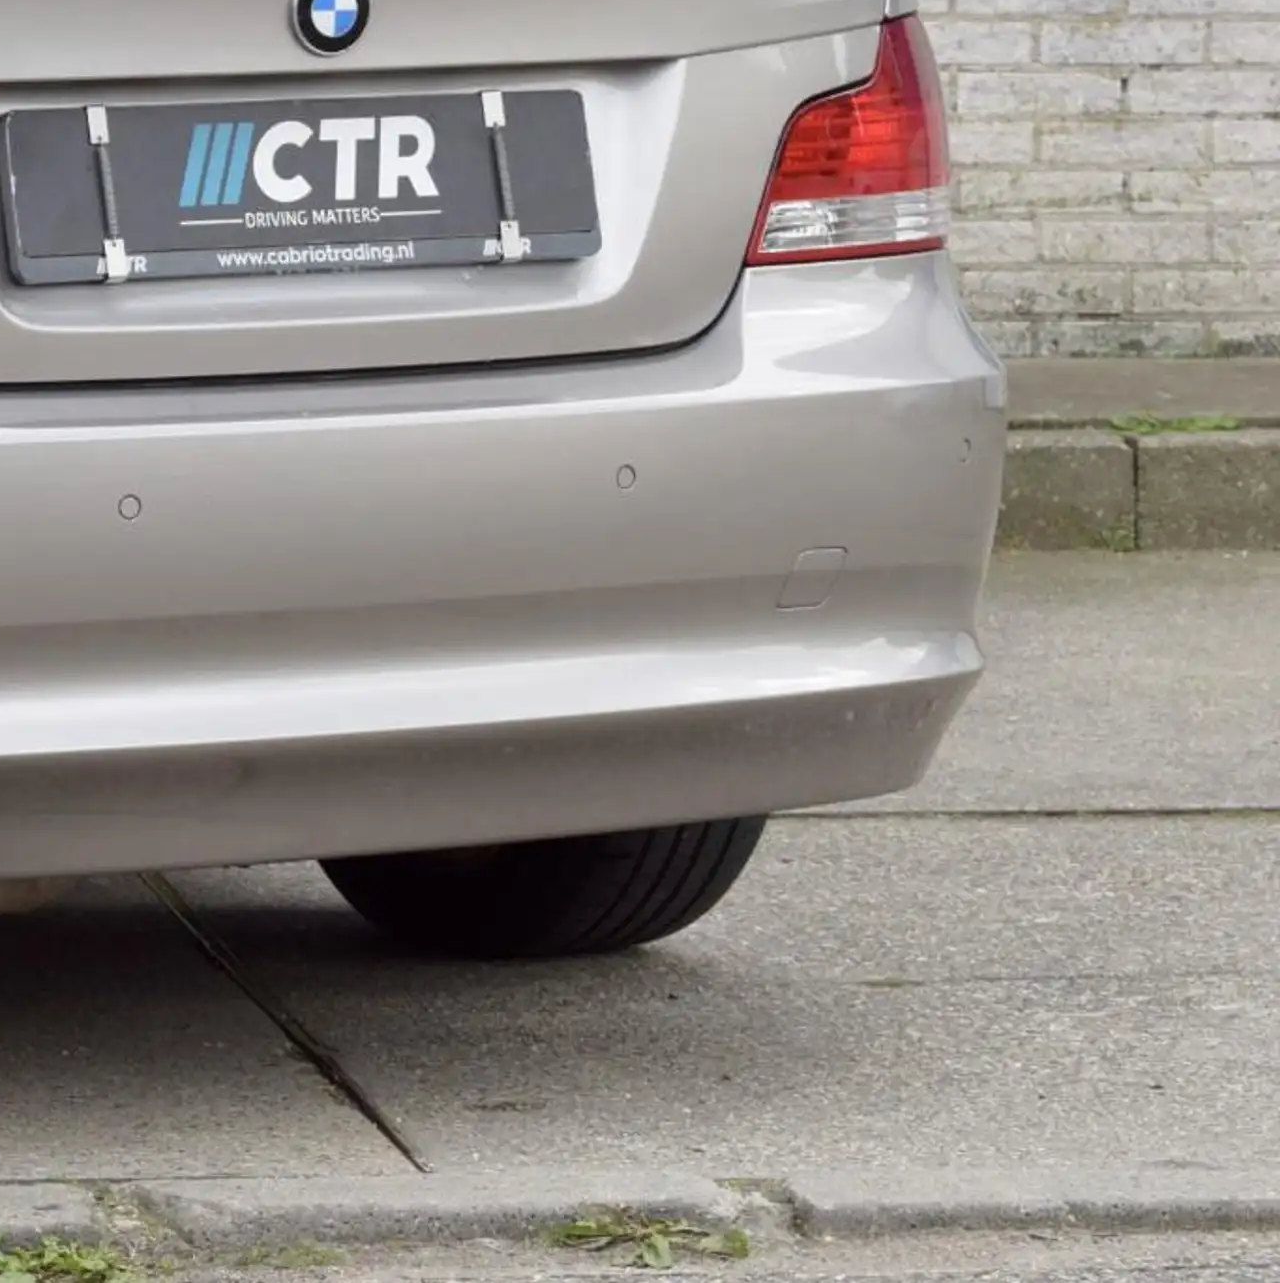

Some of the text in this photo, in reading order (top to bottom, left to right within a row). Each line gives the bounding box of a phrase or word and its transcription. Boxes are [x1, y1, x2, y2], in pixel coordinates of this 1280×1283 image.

[253, 114, 440, 204] CTR
[244, 206, 382, 229] DRIVING MATTERS
[216, 240, 416, 268] www.cabriotrading.nl
